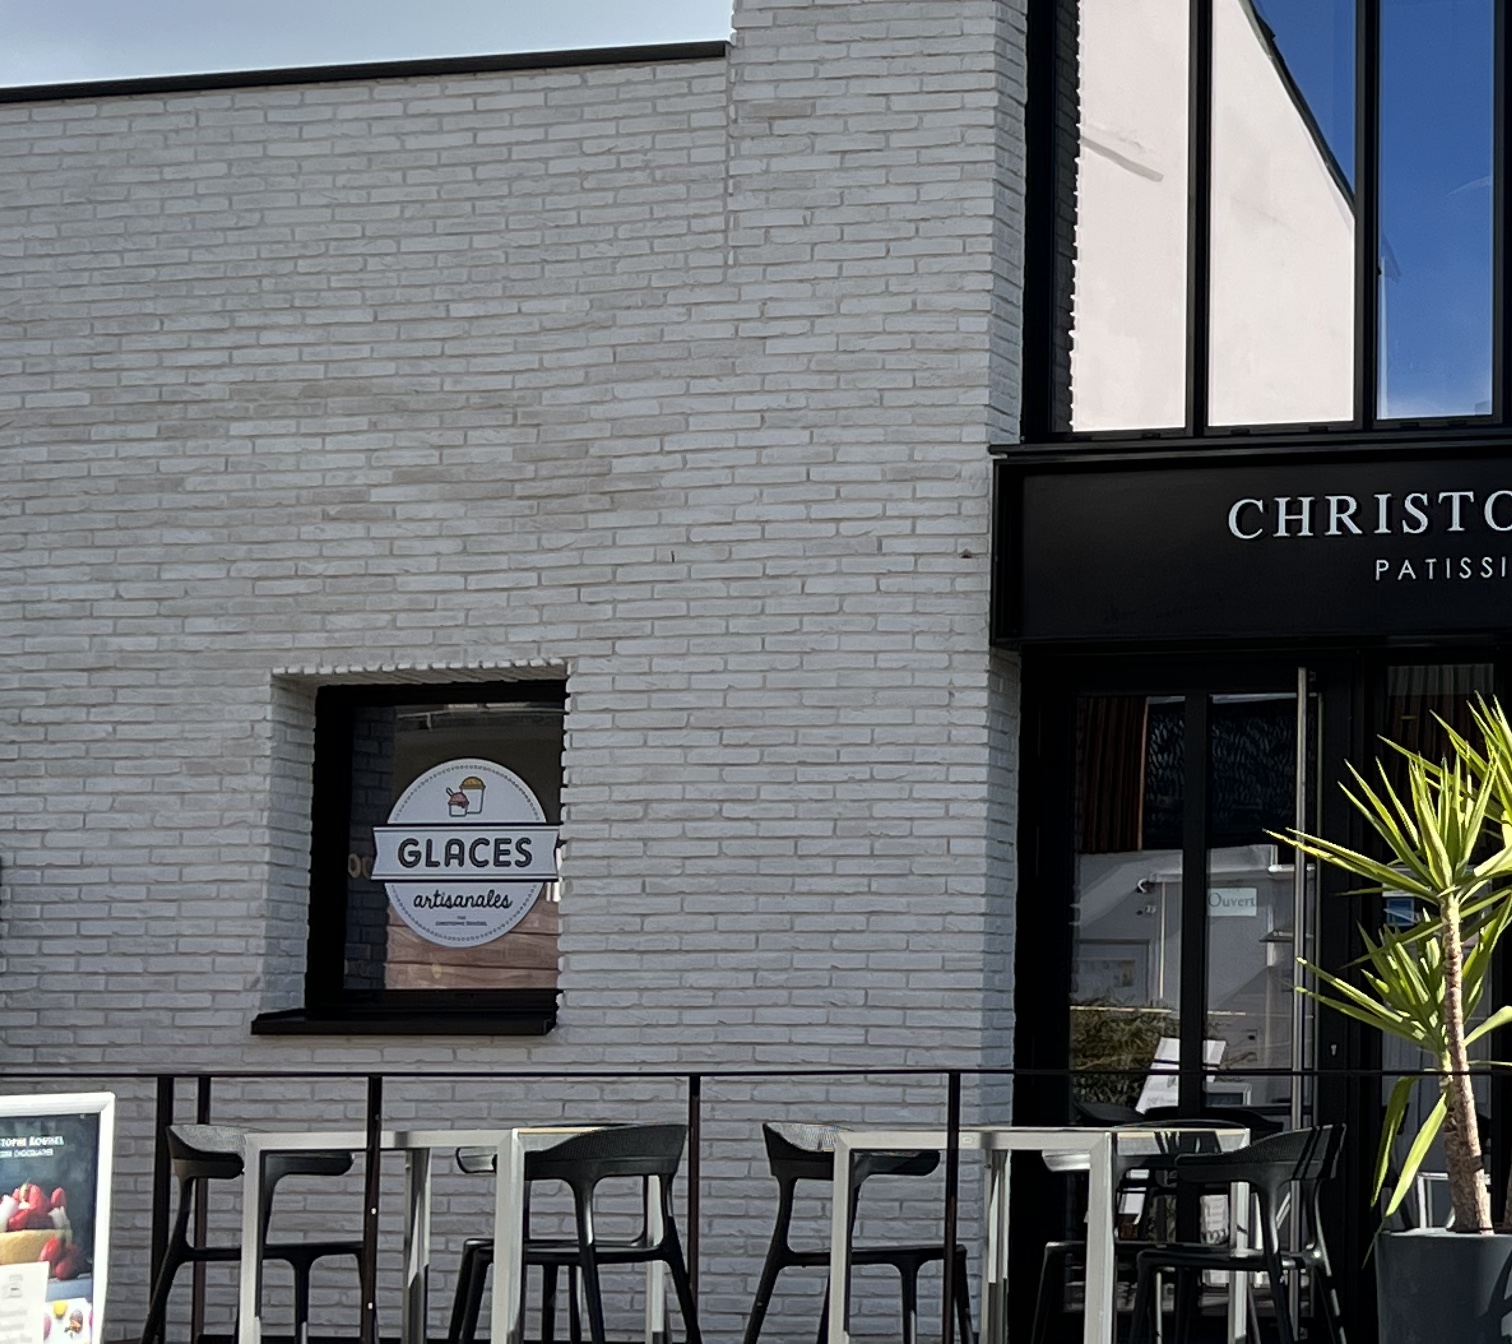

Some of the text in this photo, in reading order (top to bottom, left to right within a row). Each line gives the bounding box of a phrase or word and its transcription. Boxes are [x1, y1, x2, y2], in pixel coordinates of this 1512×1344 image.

[397, 837, 533, 869] GLACES
[413, 888, 514, 910] artisanales
[1208, 892, 1256, 908] Ouvert
